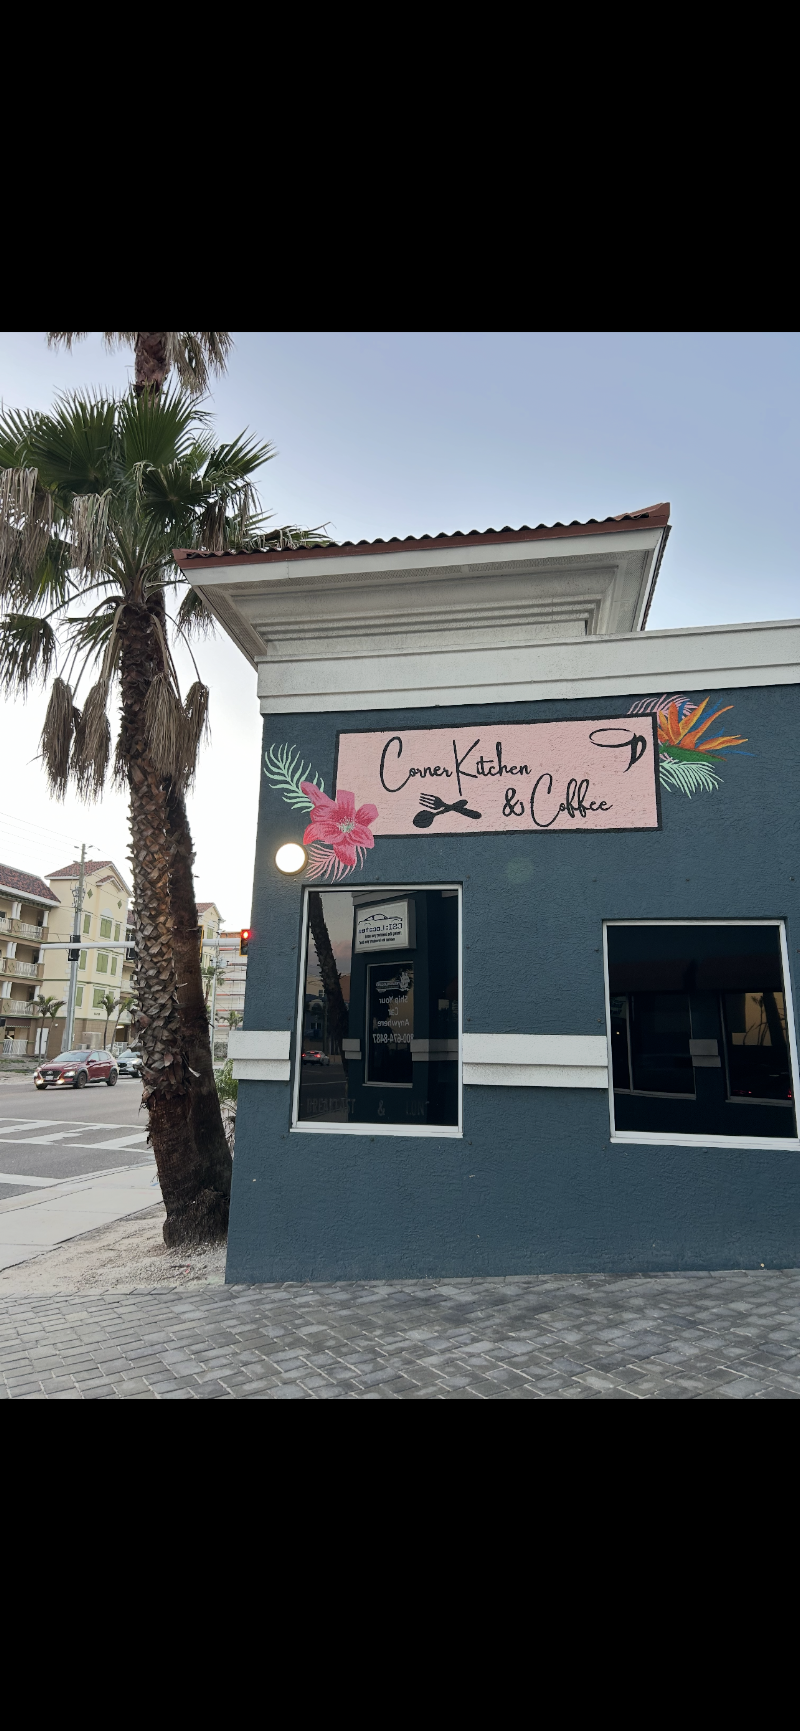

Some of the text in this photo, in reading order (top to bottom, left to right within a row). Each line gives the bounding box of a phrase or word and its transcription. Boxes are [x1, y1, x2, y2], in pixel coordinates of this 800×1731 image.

[380, 736, 532, 796] Corner Kitchen
[503, 773, 613, 827] & Coffee
